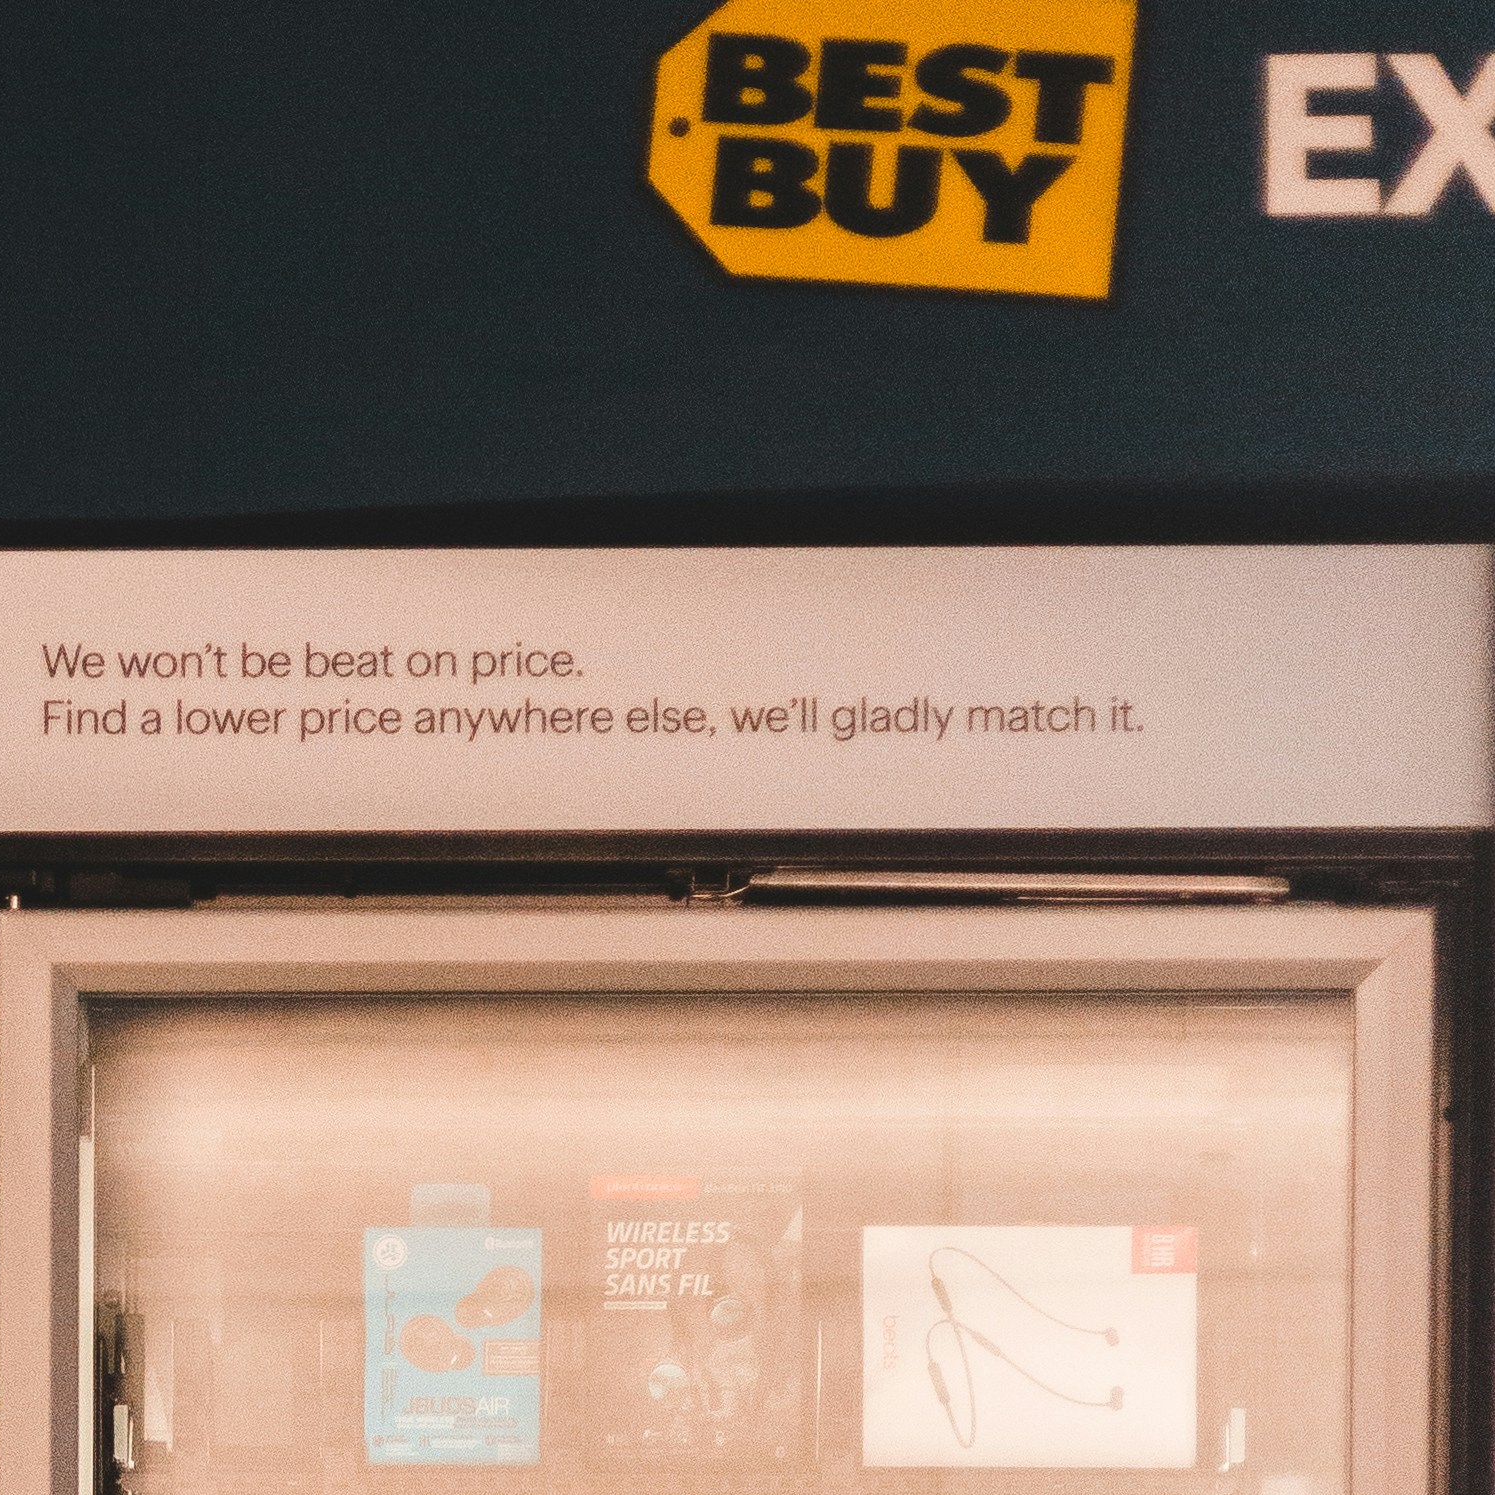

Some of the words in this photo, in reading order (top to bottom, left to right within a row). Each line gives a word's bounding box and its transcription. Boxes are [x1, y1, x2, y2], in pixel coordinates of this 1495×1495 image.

[705, 32, 1114, 145] BEST
[710, 134, 1077, 244] BUY
[42, 643, 105, 678] We
[241, 642, 292, 679] be
[305, 642, 393, 678] beat
[407, 651, 457, 678] on
[471, 645, 583, 685] price.
[43, 699, 126, 735] Find
[141, 708, 162, 735] a
[177, 700, 285, 735] lower
[300, 698, 402, 741] price
[414, 699, 614, 741] anywhere
[626, 698, 717, 737] else,
[832, 697, 953, 741] gladly
[967, 697, 1096, 733] match
[1110, 697, 1144, 733] it.
[606, 1221, 731, 1244] WIRELESS
[605, 1248, 687, 1269] SPORT
[605, 1274, 672, 1297] SANS
[677, 1274, 713, 1297] FIL
